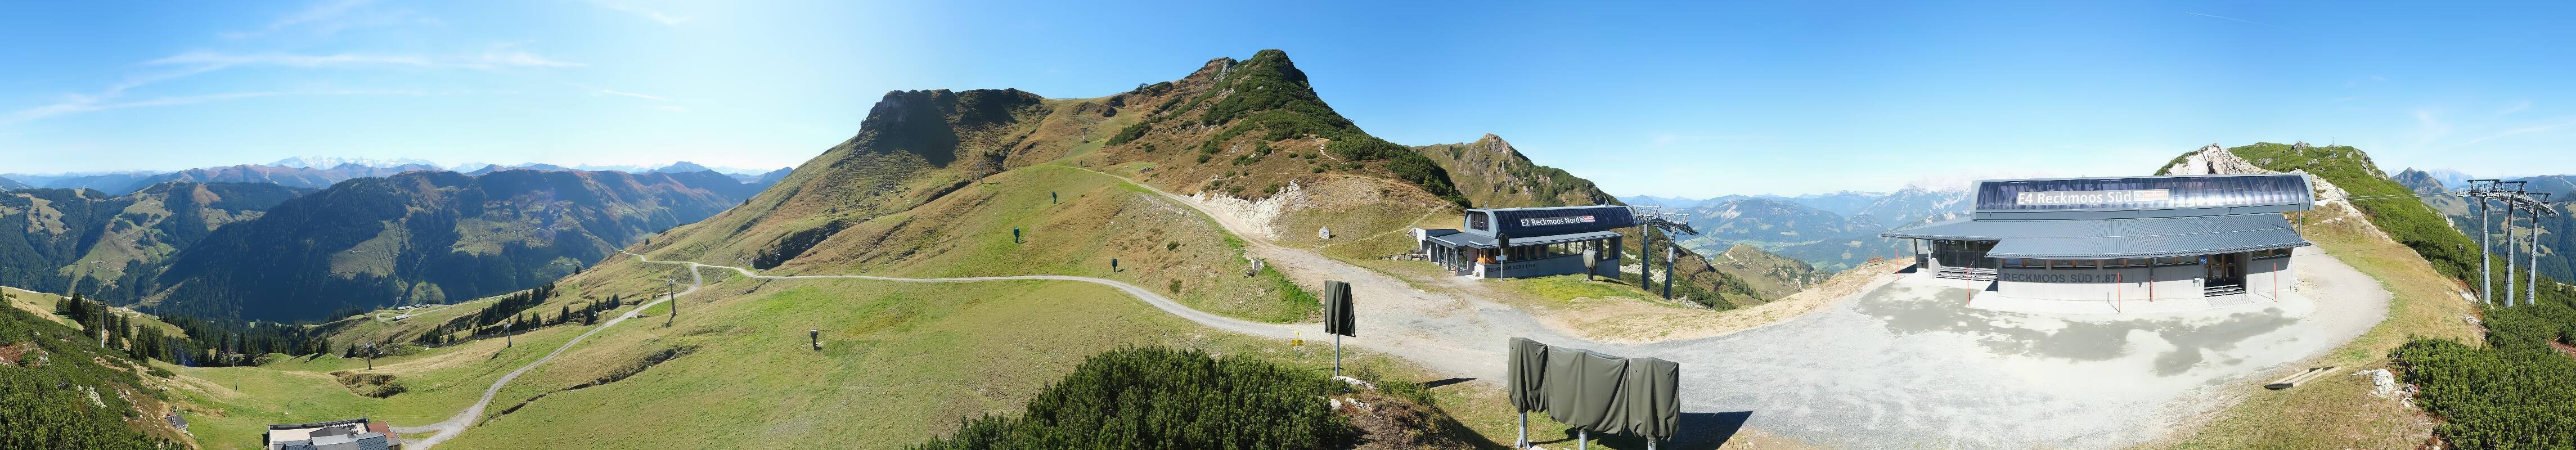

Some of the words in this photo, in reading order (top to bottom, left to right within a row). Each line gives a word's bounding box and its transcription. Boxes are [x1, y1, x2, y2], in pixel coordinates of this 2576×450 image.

[2018, 193, 2033, 204] E4
[2037, 192, 2103, 204] Reckmoos
[2107, 191, 2131, 202] Süd
[1531, 218, 1564, 226] Reckmoos
[2004, 273, 2065, 283] RECKMOOS
[2071, 272, 2093, 283] SÜD
[2096, 274, 2123, 283] 1.870
